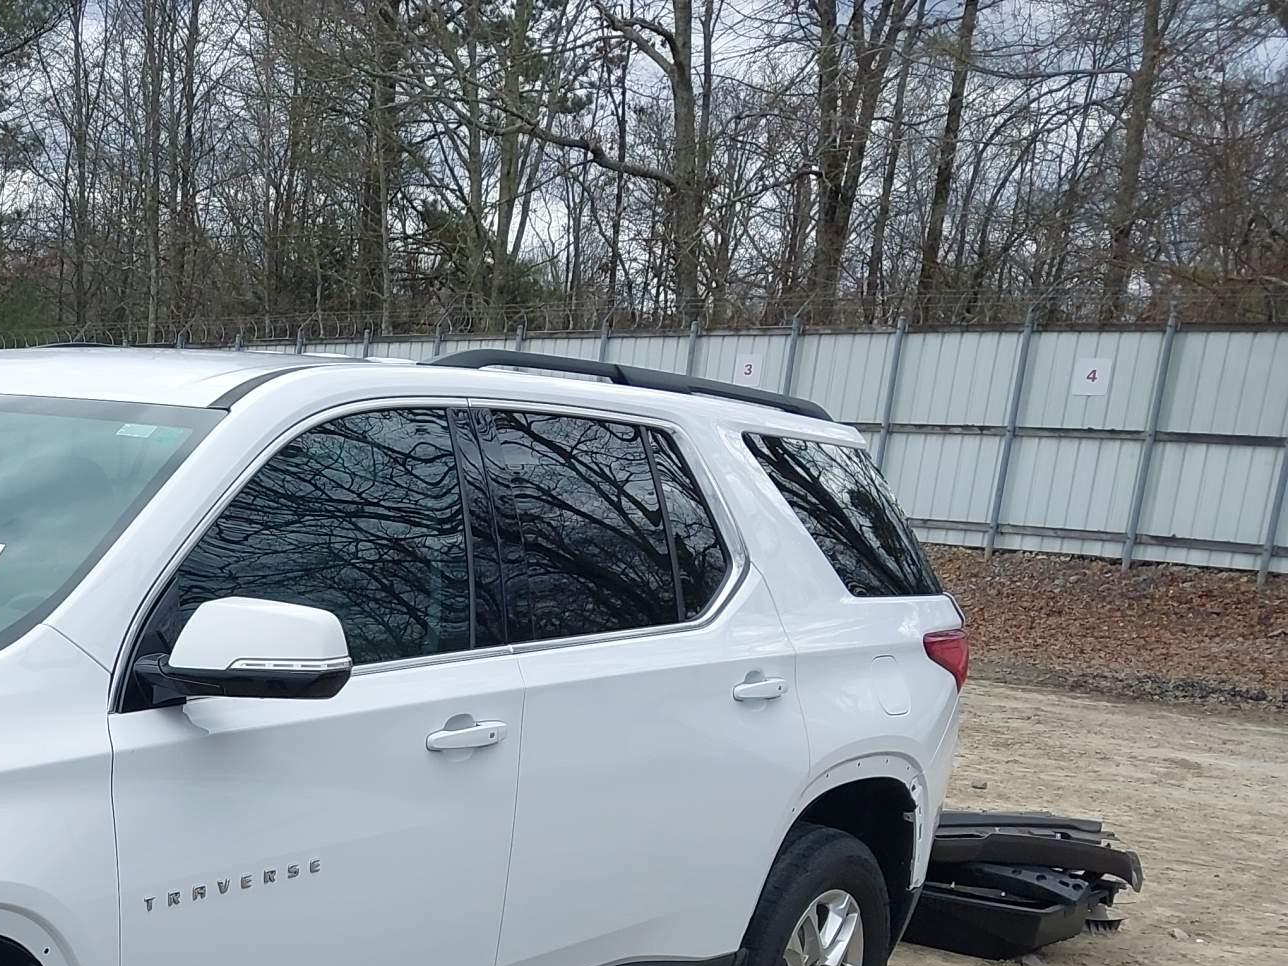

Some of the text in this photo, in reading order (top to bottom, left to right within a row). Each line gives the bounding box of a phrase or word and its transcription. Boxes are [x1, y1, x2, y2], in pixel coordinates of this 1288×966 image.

[743, 363, 753, 376] 3
[1086, 369, 1098, 383] 4
[143, 858, 321, 912] TRAVERSE
